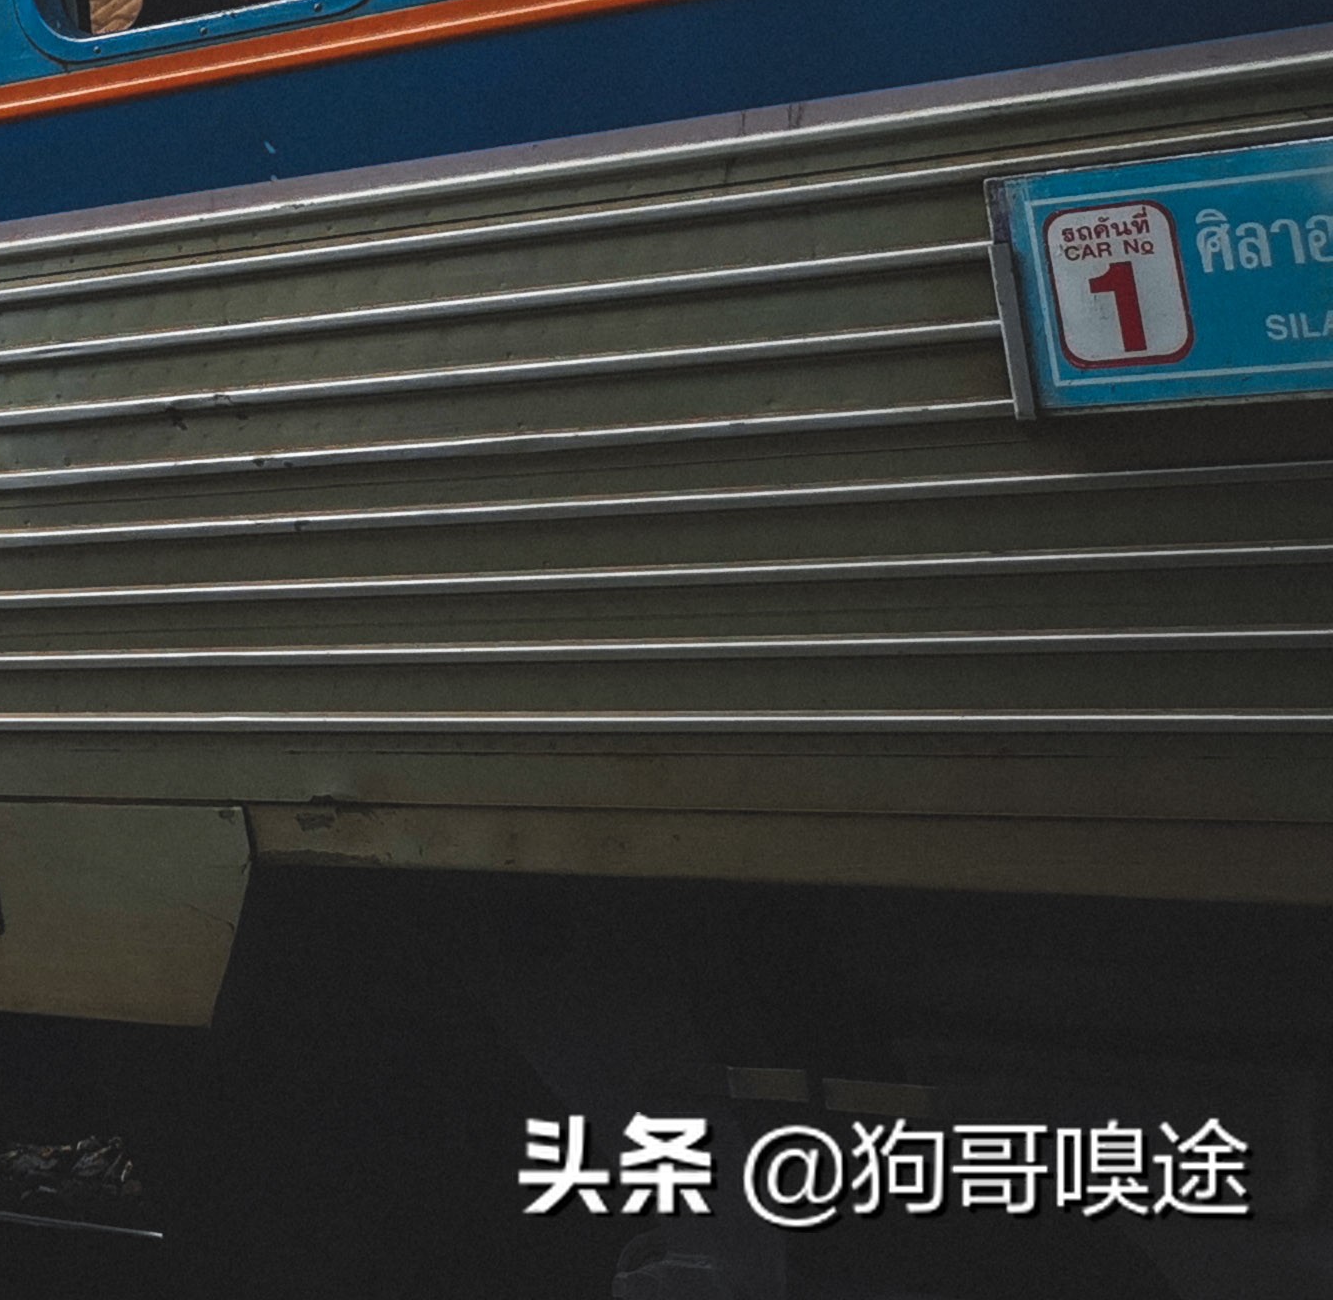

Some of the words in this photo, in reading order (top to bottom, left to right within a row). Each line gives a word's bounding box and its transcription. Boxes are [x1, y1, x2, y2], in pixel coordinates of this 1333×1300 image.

[1061, 206, 1151, 243] รถคันที่
[1063, 241, 1112, 262] CAR
[1088, 260, 1148, 352] 1
